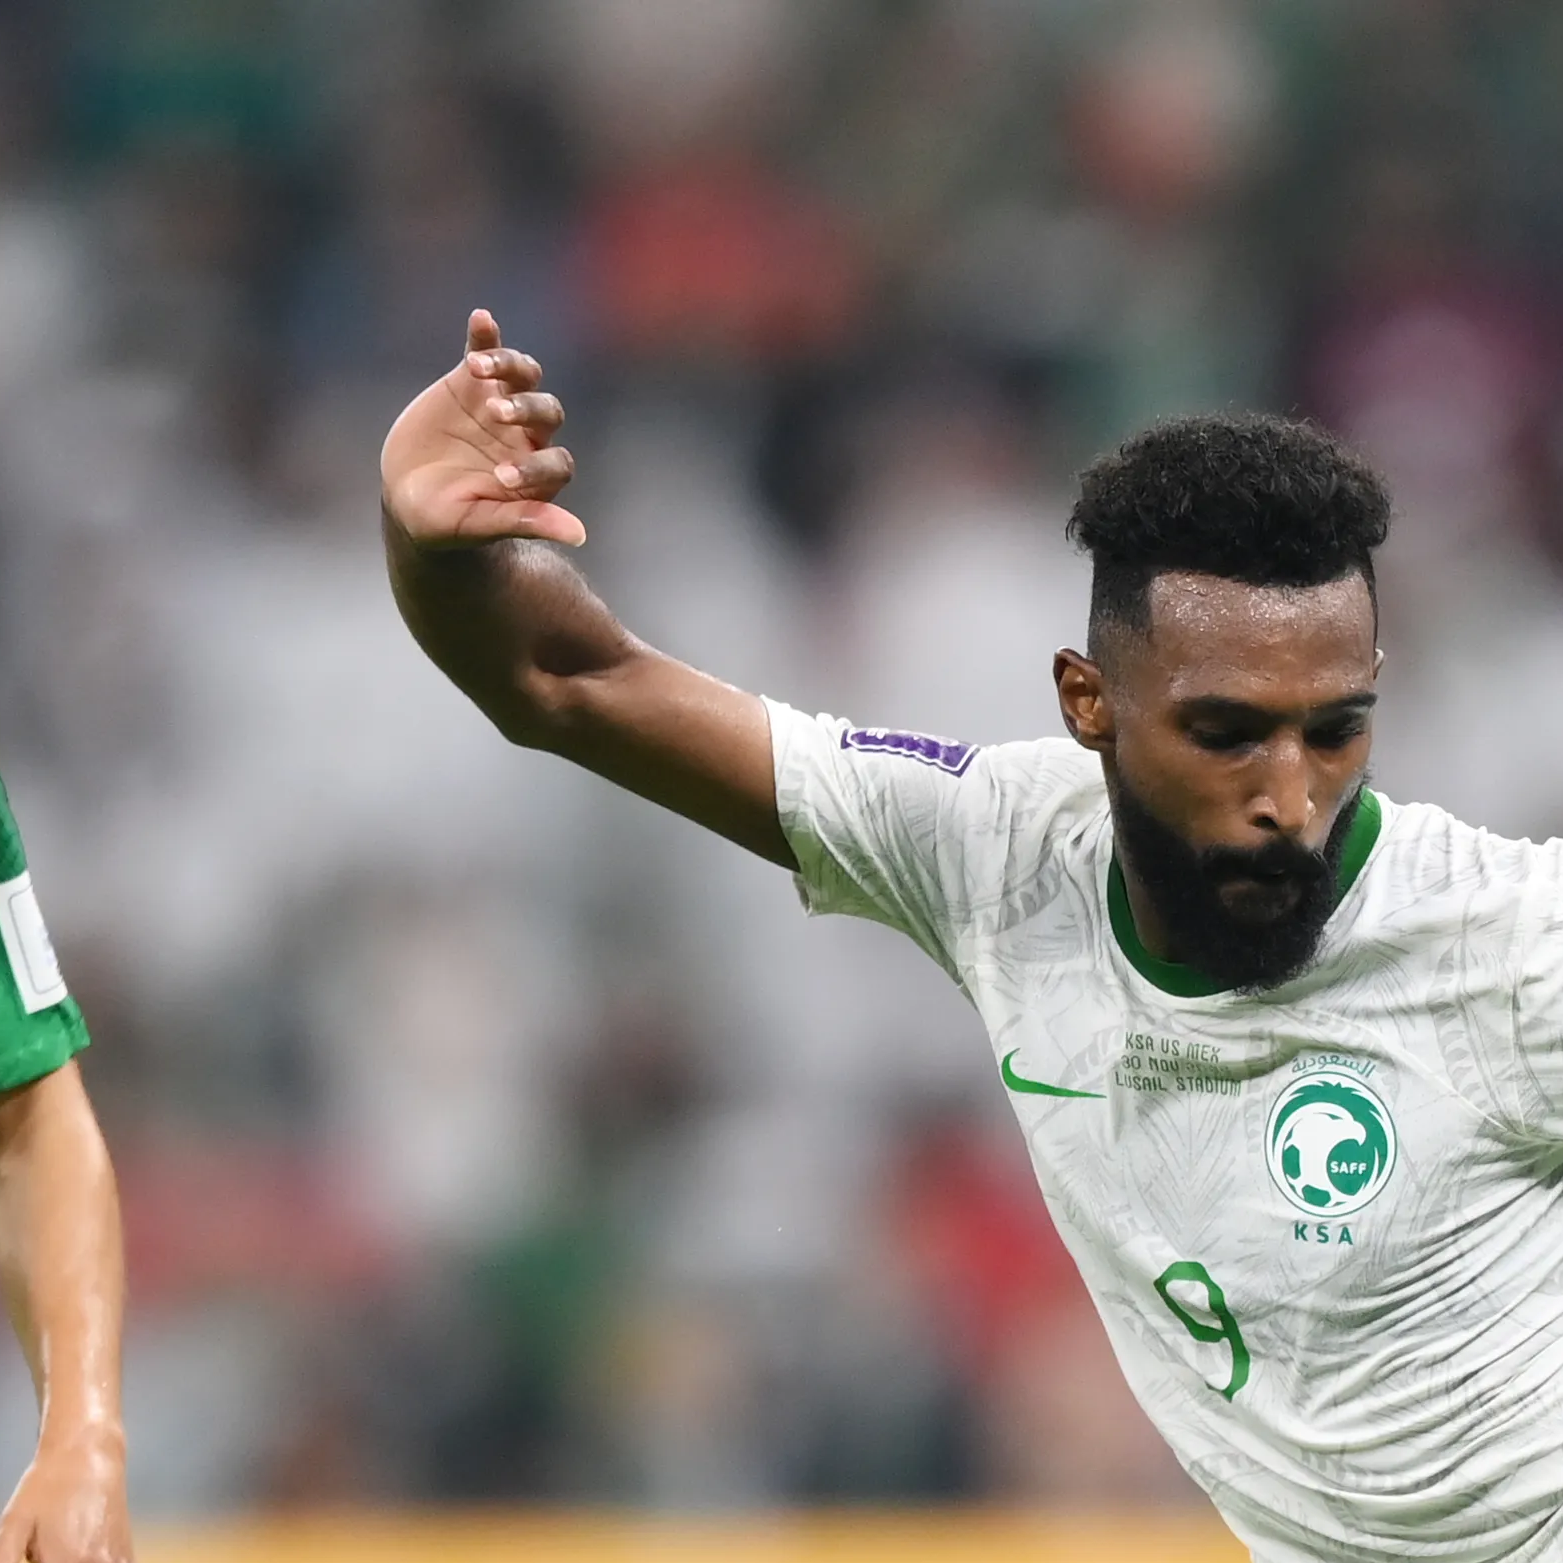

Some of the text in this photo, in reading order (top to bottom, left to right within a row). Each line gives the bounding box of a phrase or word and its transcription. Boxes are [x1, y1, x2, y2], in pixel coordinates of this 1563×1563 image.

[1125, 1031, 1154, 1052] KSA
[1187, 1042, 1221, 1063] MEX
[1121, 1055, 1141, 1070] 30
[1292, 1054, 1376, 1078] السعودية
[1115, 1071, 1241, 1098] LUSAIL STADIUM
[1330, 1161, 1367, 1175] SAFF
[1153, 1261, 1250, 1403] 9
